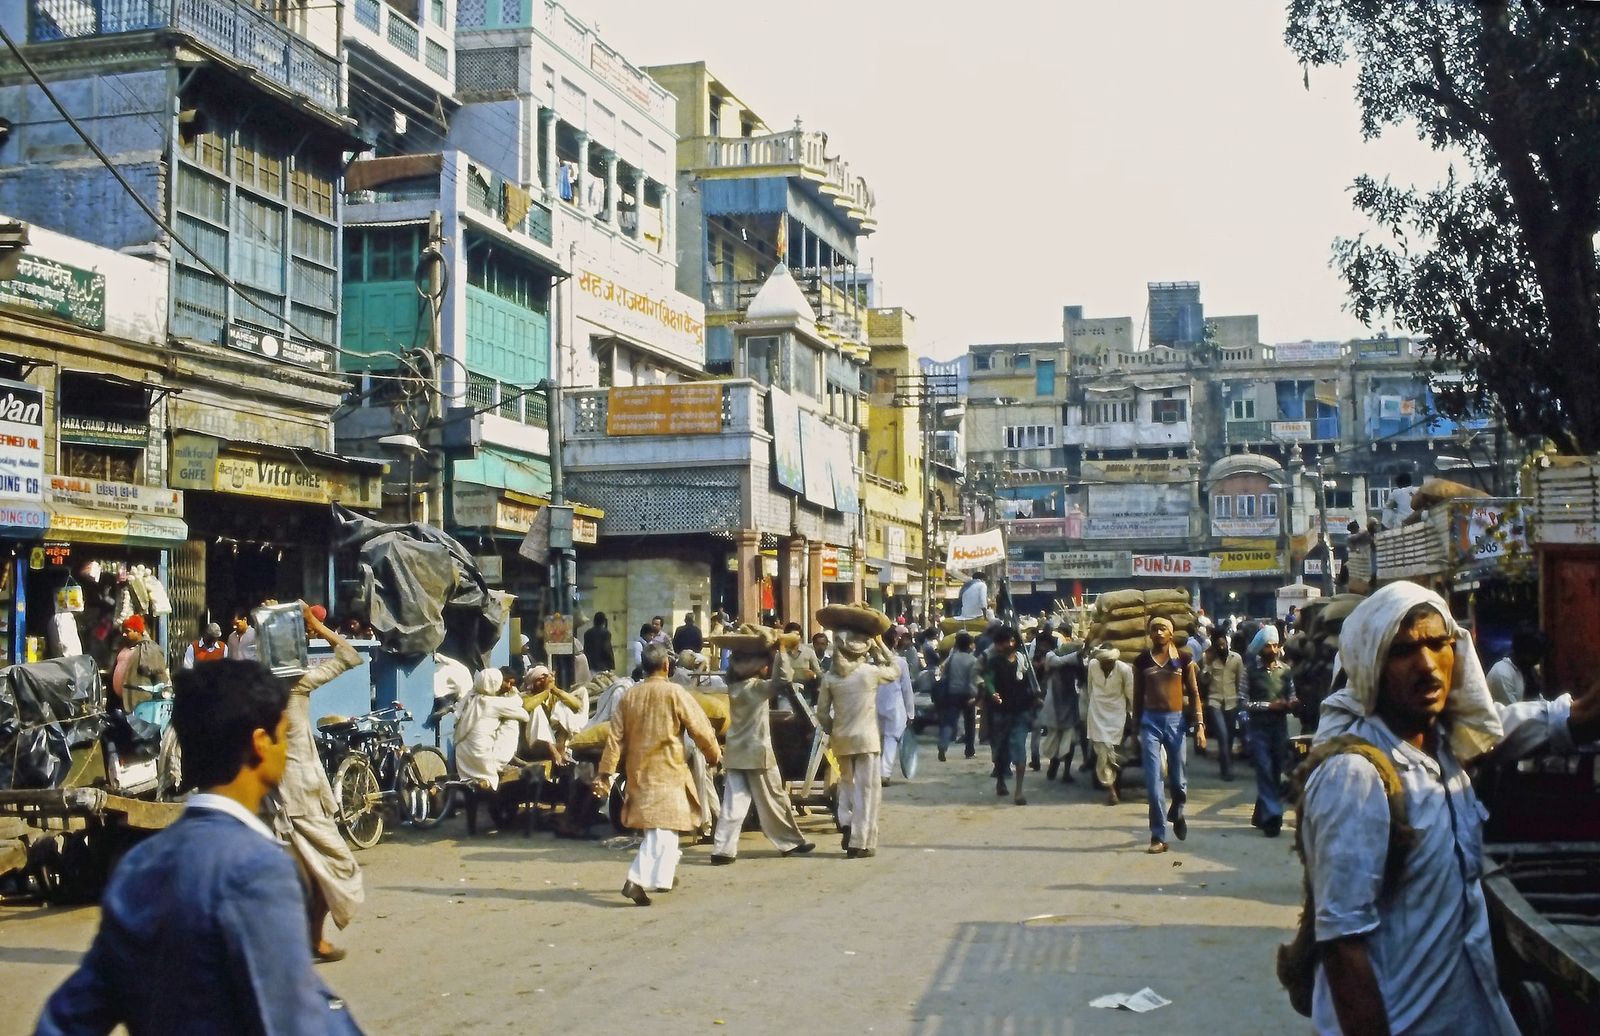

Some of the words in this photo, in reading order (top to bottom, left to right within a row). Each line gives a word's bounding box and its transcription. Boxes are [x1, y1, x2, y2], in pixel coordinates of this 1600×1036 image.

[61, 417, 80, 429] TARA
[81, 419, 105, 432] CHAND
[106, 422, 122, 434] RAM
[27, 438, 40, 450] OIL
[180, 468, 206, 480] GHEE
[257, 460, 291, 487] Vita
[294, 470, 320, 489] GHEE
[1227, 551, 1272, 562] NOVINO
[1133, 556, 1191, 574] PUNJAB
